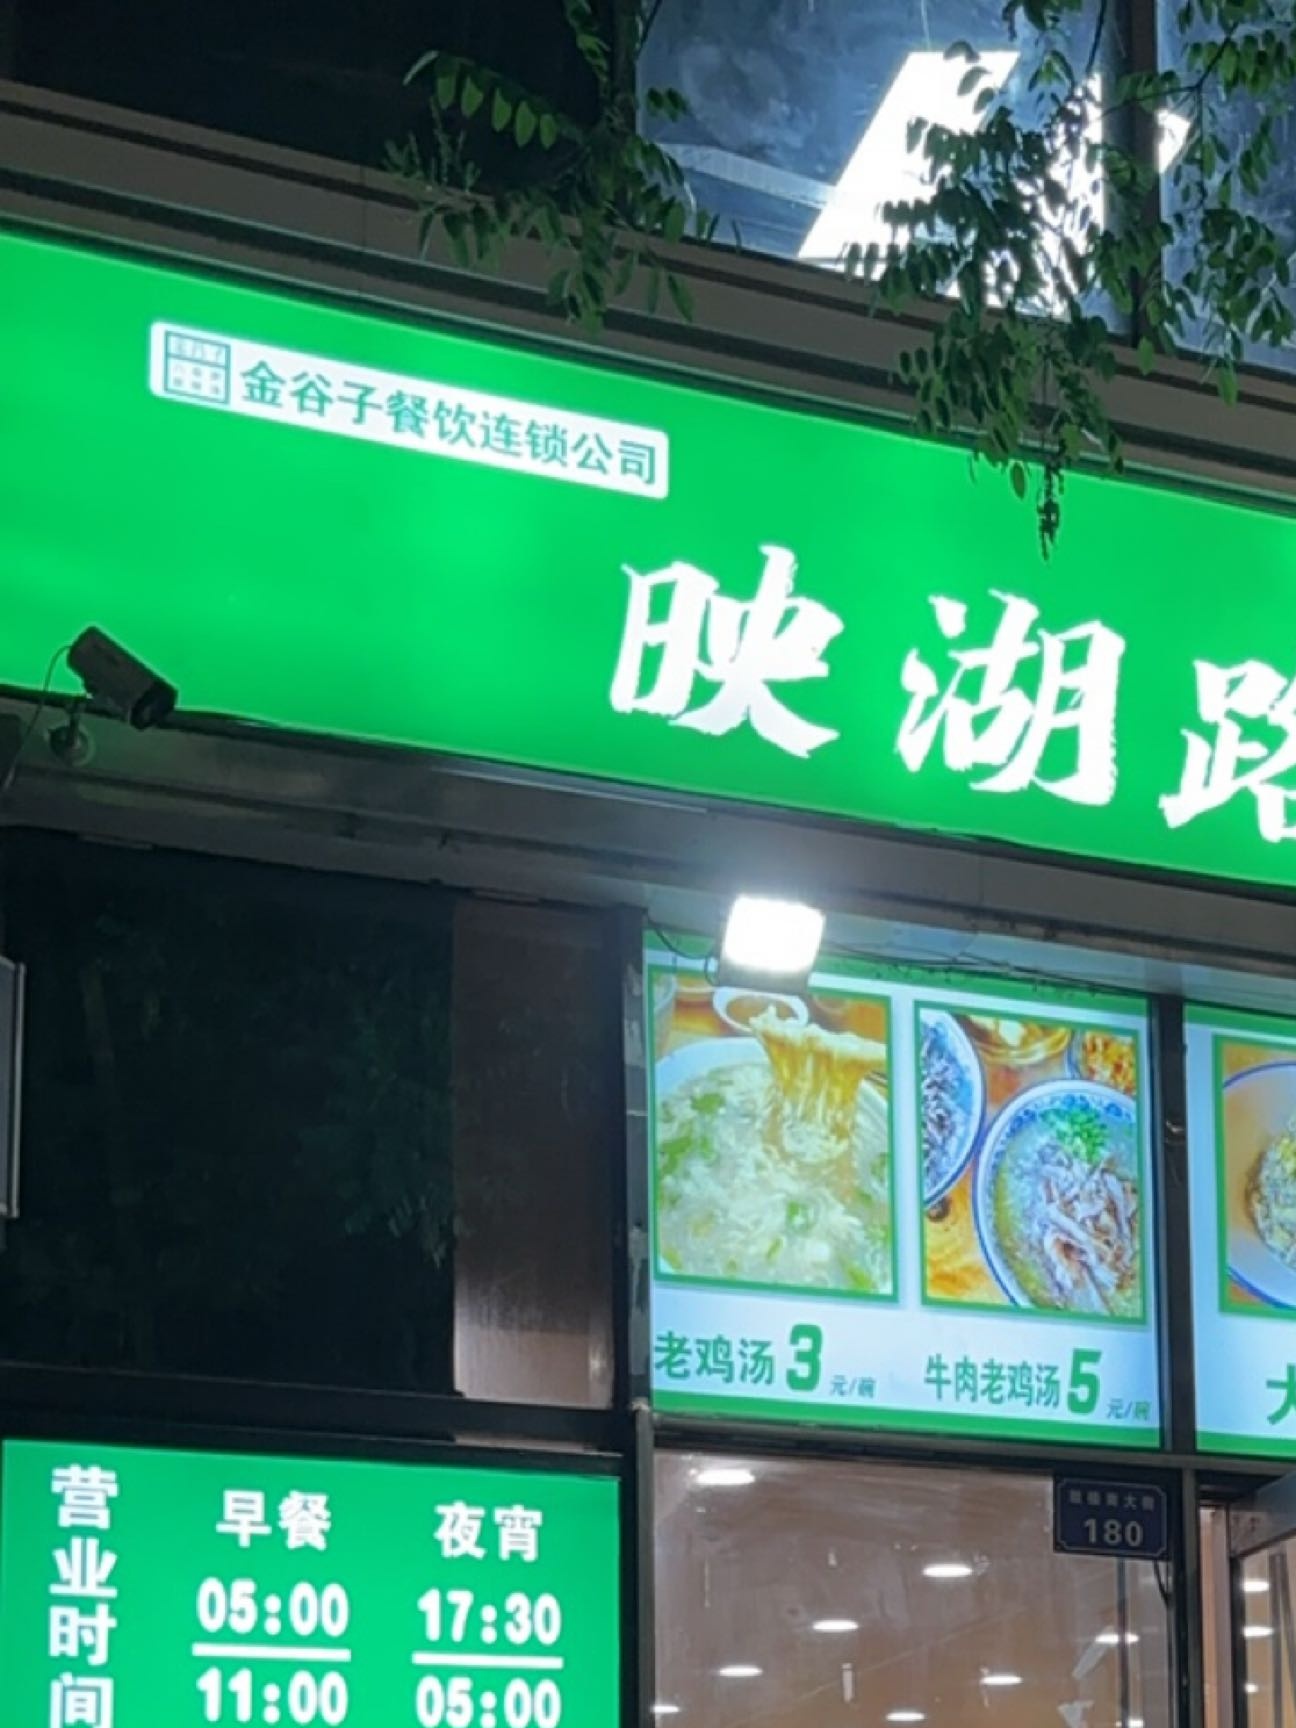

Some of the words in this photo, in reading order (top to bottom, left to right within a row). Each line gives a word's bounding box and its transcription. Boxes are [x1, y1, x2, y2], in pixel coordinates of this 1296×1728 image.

[240, 358, 658, 486] 金谷子餐饮连锁公司
[653, 1330, 775, 1386] 老鸡汤
[785, 1323, 824, 1393] 3
[924, 1352, 1060, 1408] 牛肉老鸡汤
[1066, 1347, 1102, 1415] 5
[216, 1490, 332, 1551] 早餐
[433, 1501, 543, 1563] 夜宵
[1083, 1518, 1143, 1547] 180
[196, 1577, 350, 1638] 05:00
[417, 1588, 562, 1646] 17:30
[196, 1667, 349, 1726] 11:00
